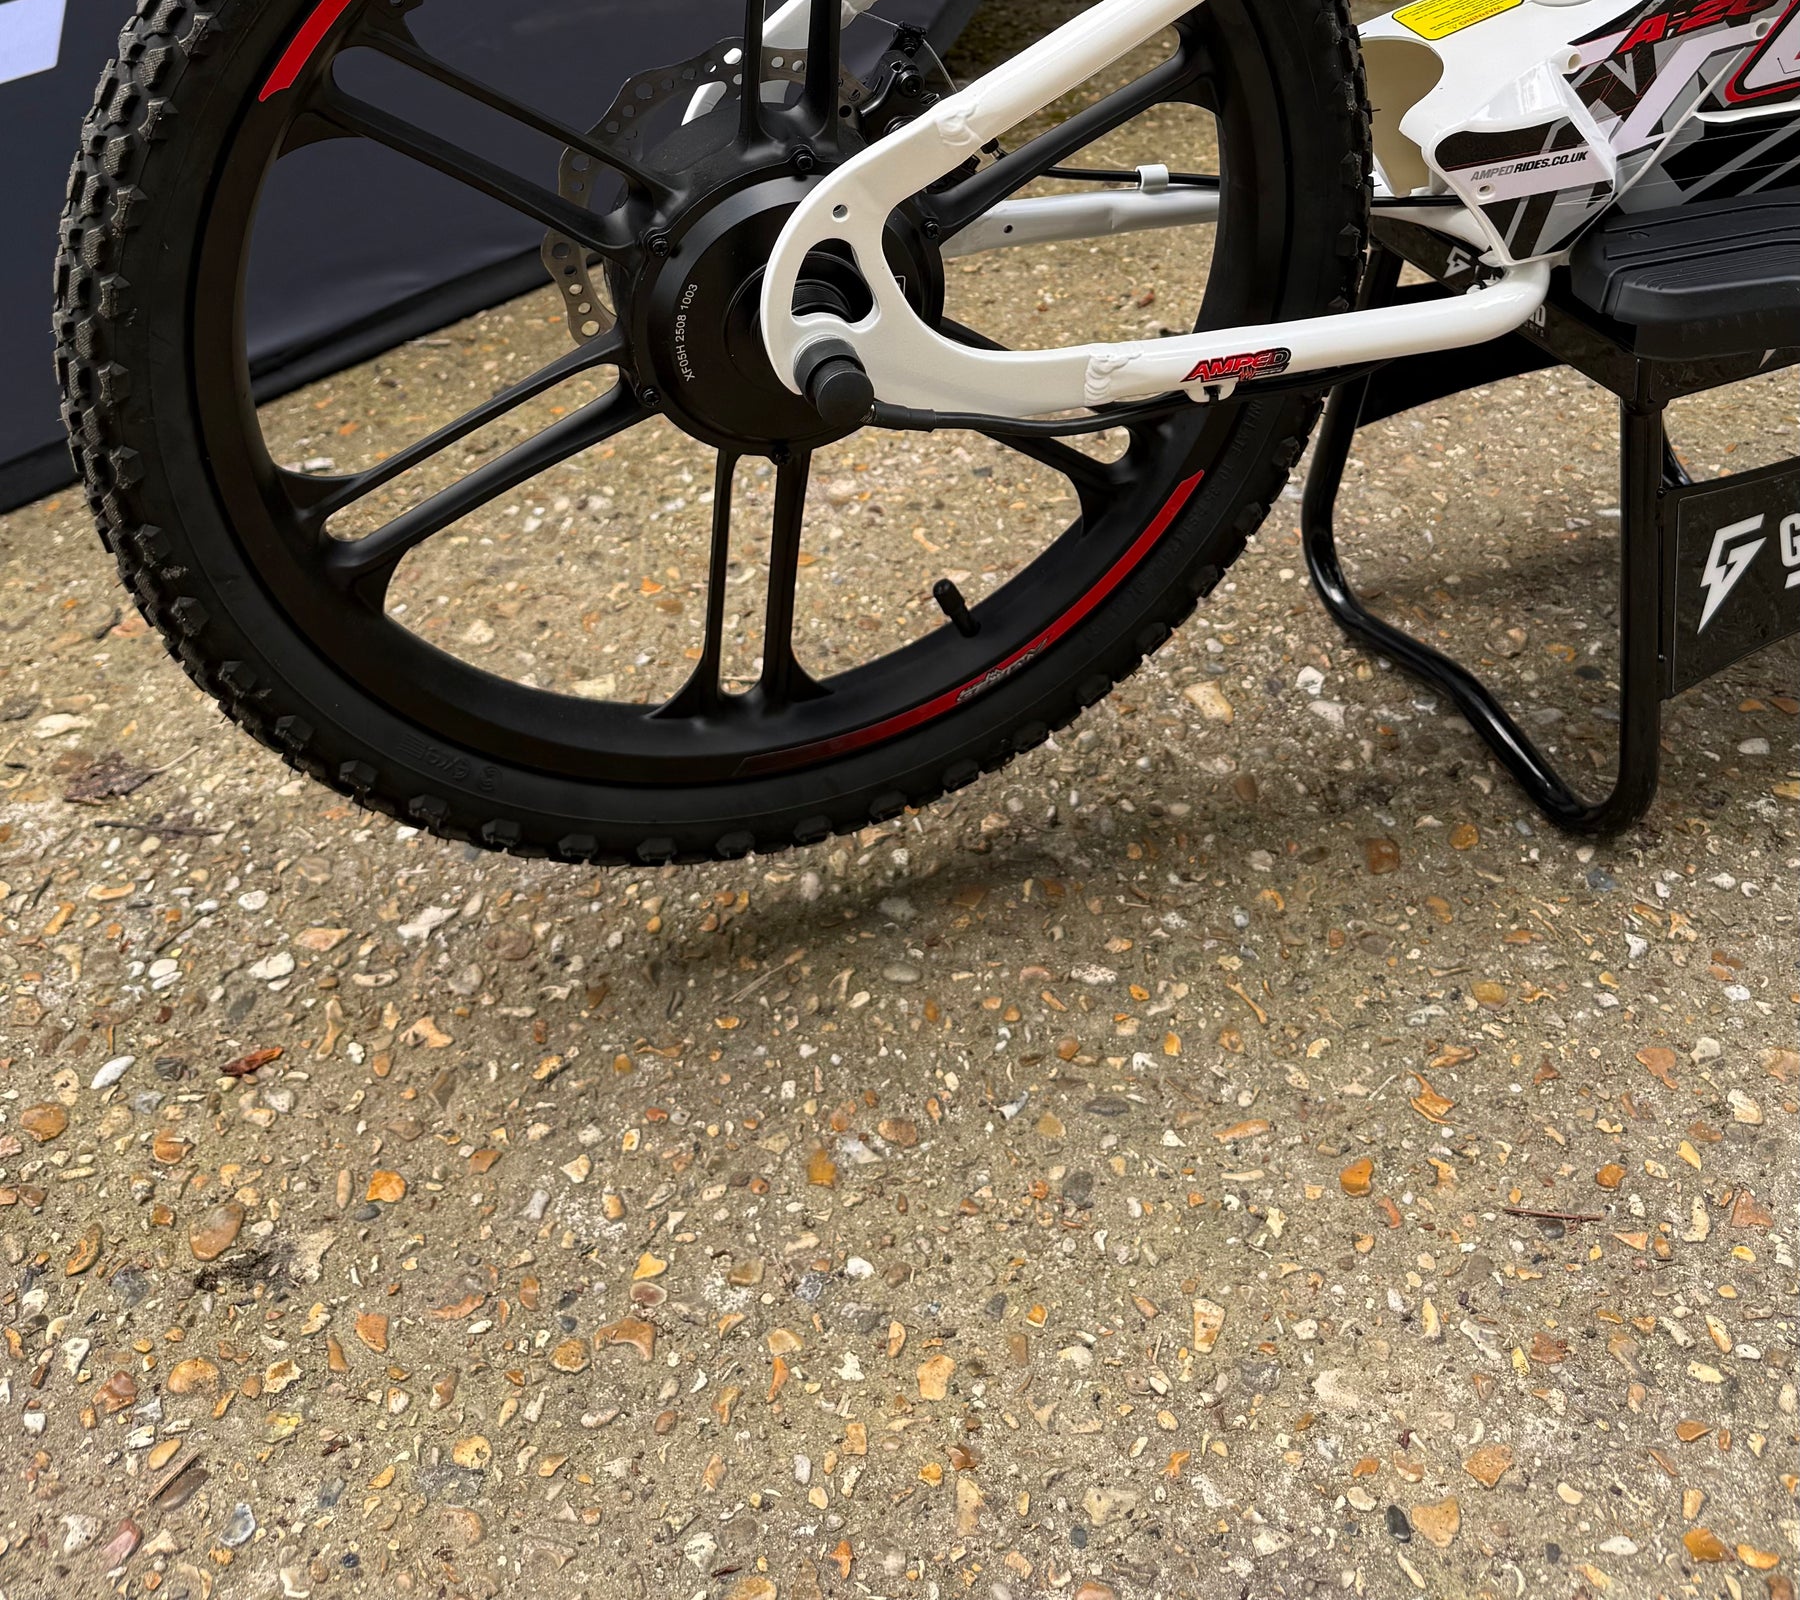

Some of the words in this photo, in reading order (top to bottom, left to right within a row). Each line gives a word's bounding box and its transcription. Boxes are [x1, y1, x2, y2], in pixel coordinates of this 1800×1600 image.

[1471, 151, 1588, 181] AMPEDRIDES.CO.UK
[680, 283, 698, 310] 1003
[675, 314, 687, 342] 2508
[676, 344, 696, 382] XF05H
[1184, 350, 1290, 381] AMPED
